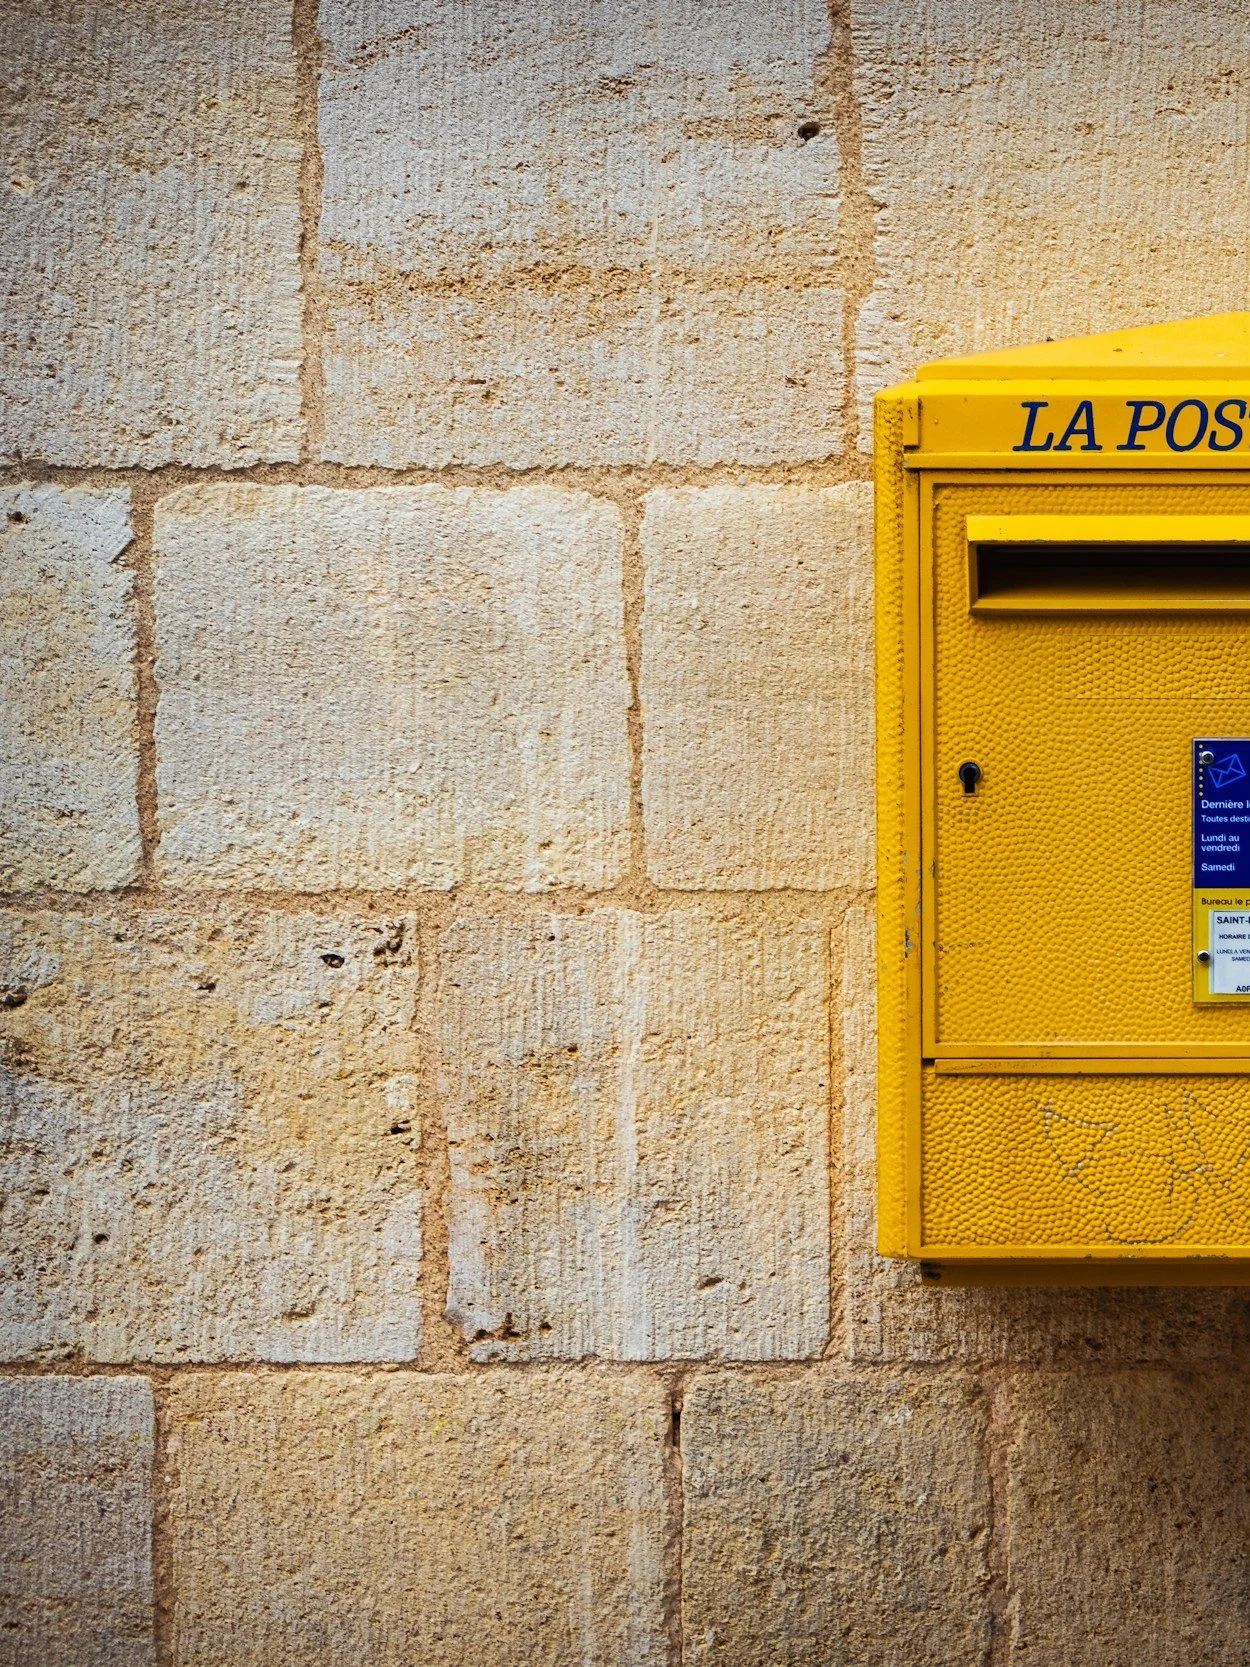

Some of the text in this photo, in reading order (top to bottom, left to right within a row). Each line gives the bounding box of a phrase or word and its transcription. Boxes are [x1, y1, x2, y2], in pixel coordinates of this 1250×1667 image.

[1012, 400, 1103, 452] LA
[1201, 799, 1244, 809] Dernière
[1201, 814, 1228, 823] Toutes
[1201, 833, 1226, 842] Lundi
[1201, 844, 1240, 852] vendredi
[1201, 862, 1235, 872] Samedi
[1201, 897, 1233, 906] Bureau
[1235, 897, 1243, 906] le
